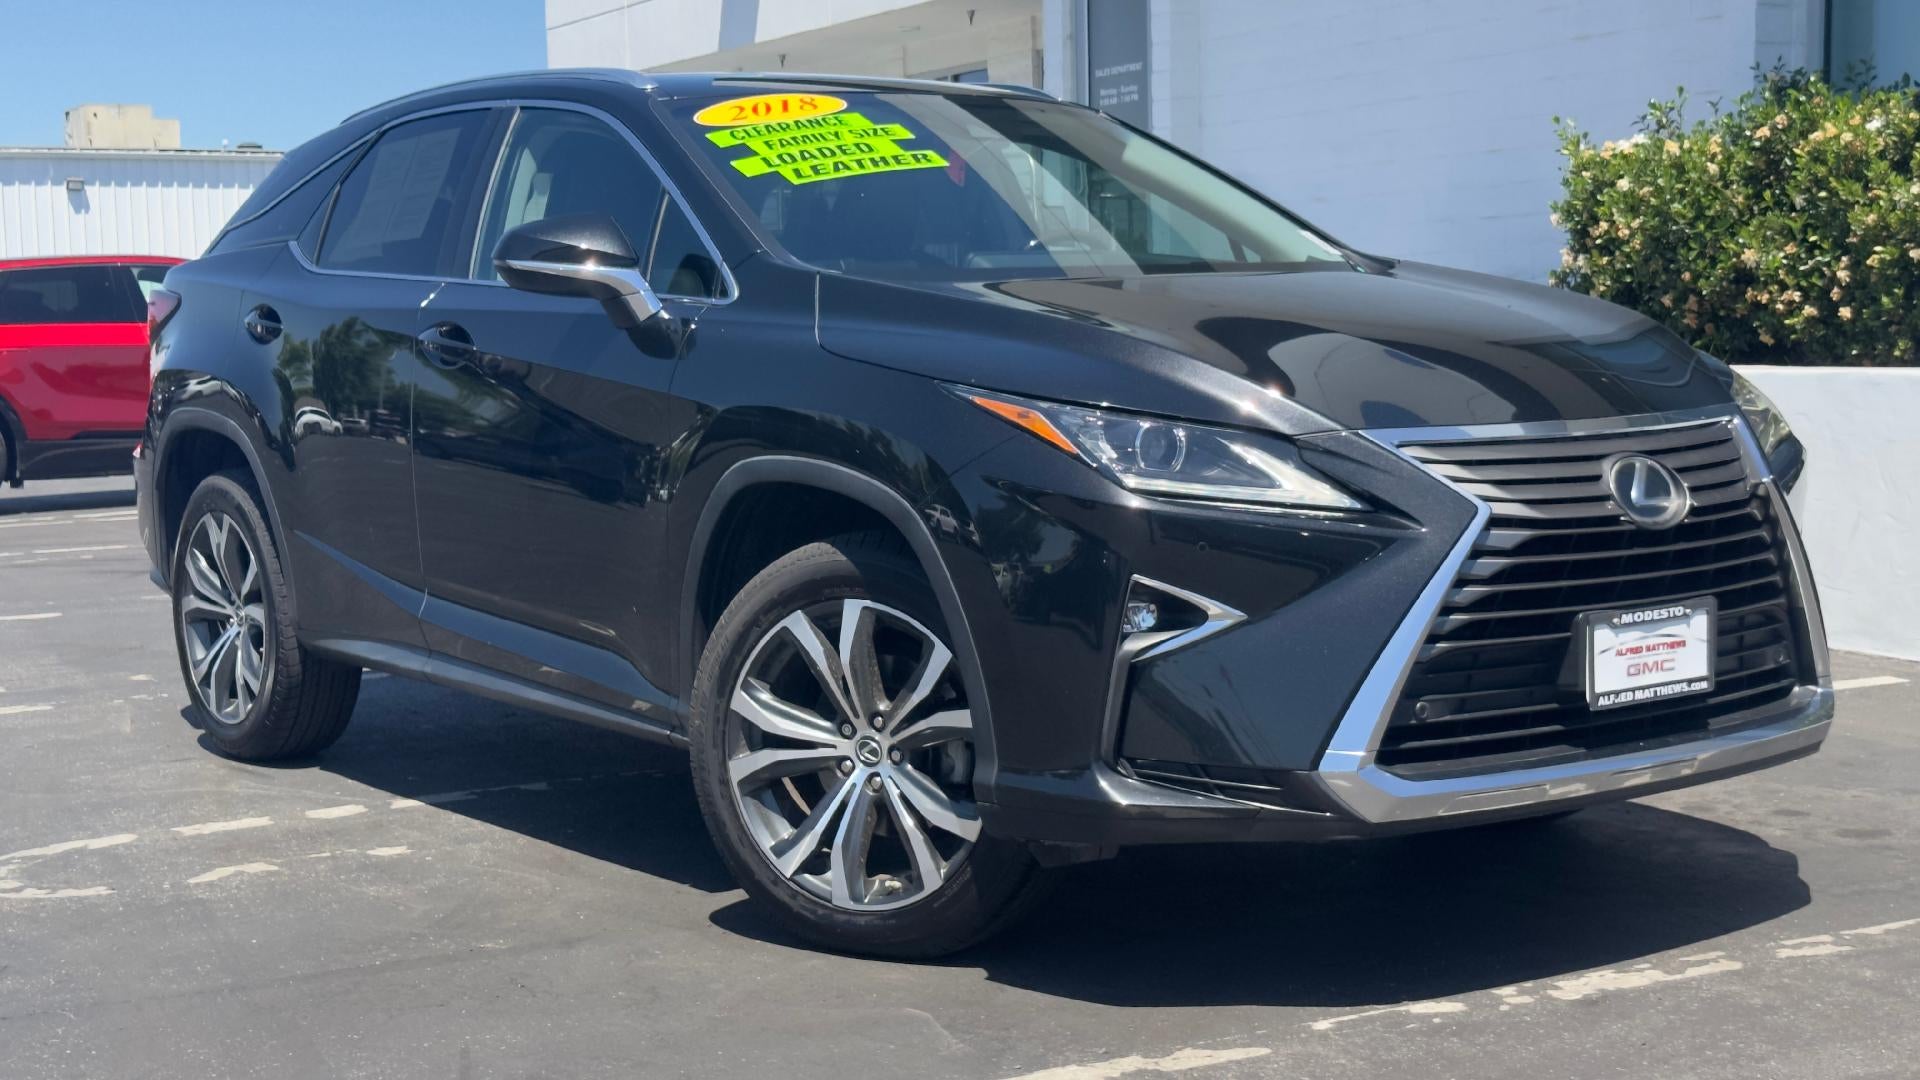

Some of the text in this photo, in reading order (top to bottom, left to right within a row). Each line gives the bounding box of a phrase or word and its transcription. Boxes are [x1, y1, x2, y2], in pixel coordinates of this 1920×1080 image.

[729, 97, 819, 122] 2018
[729, 115, 849, 141] CLEARANCE
[763, 126, 897, 151] FAMILY SIZE
[761, 142, 875, 168] LOADED
[793, 153, 933, 179] LEATHER
[1620, 606, 1684, 624] MODESTO
[1615, 646, 1643, 656] ALFRED
[1645, 640, 1686, 653] MATTHEWS
[1627, 658, 1675, 676] GMC
